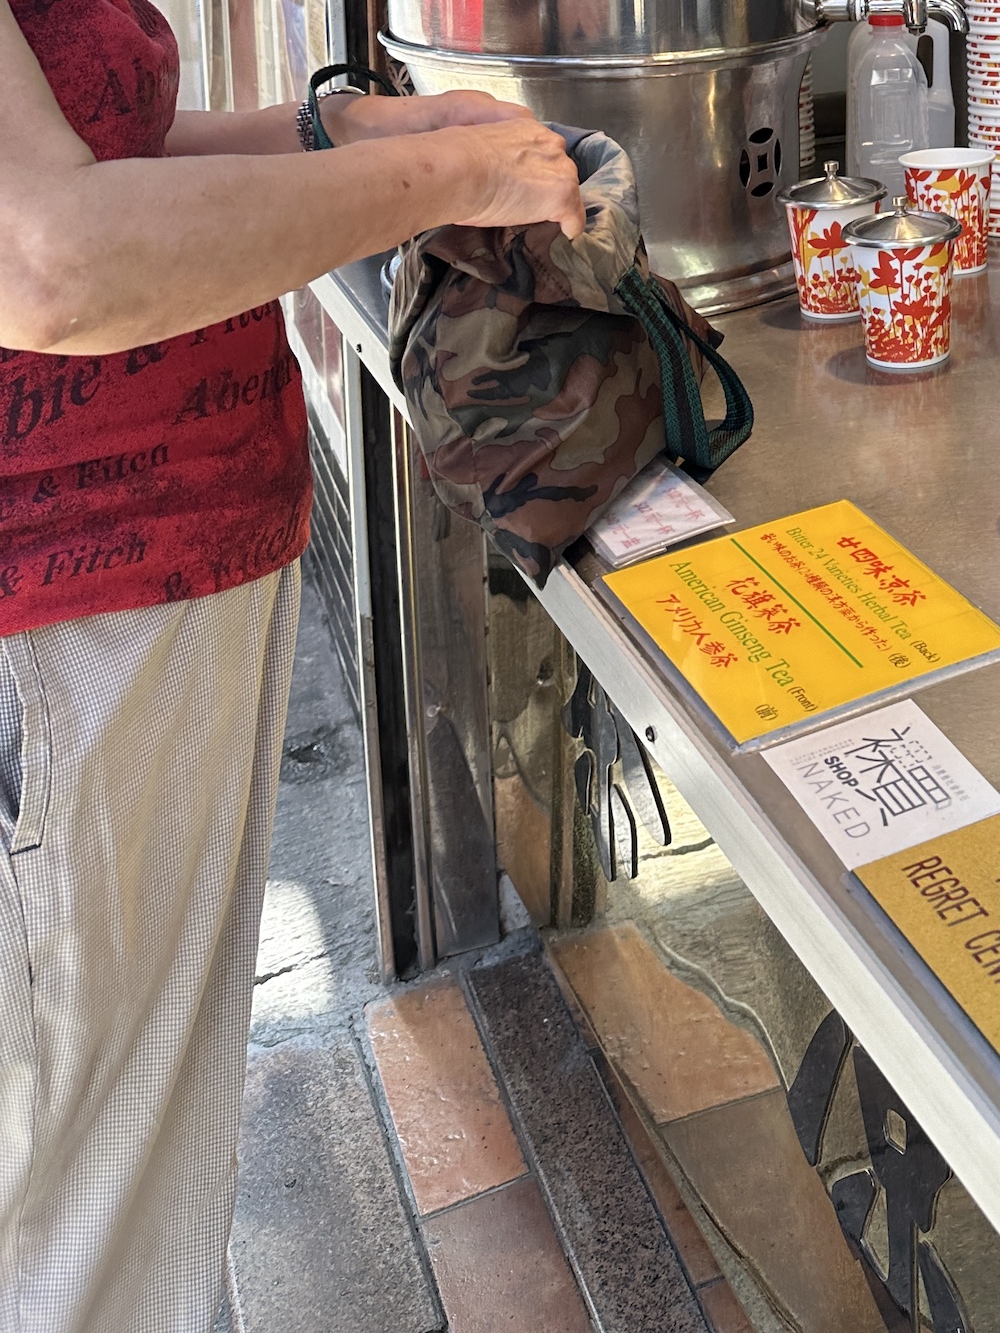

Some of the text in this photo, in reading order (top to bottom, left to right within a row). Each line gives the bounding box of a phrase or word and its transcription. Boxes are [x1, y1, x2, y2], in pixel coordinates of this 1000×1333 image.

[39, 532, 148, 587] Fitch
[786, 527, 941, 664] Bitter 24 Varieties Herbal Tea (Back)
[669, 561, 819, 713] American Ginseng Tea (Front)
[888, 652, 911, 669] (後)
[754, 703, 779, 721] (前)
[797, 762, 870, 839] NAKED
[824, 755, 859, 788] SHOP
[901, 855, 989, 928] REGRET
